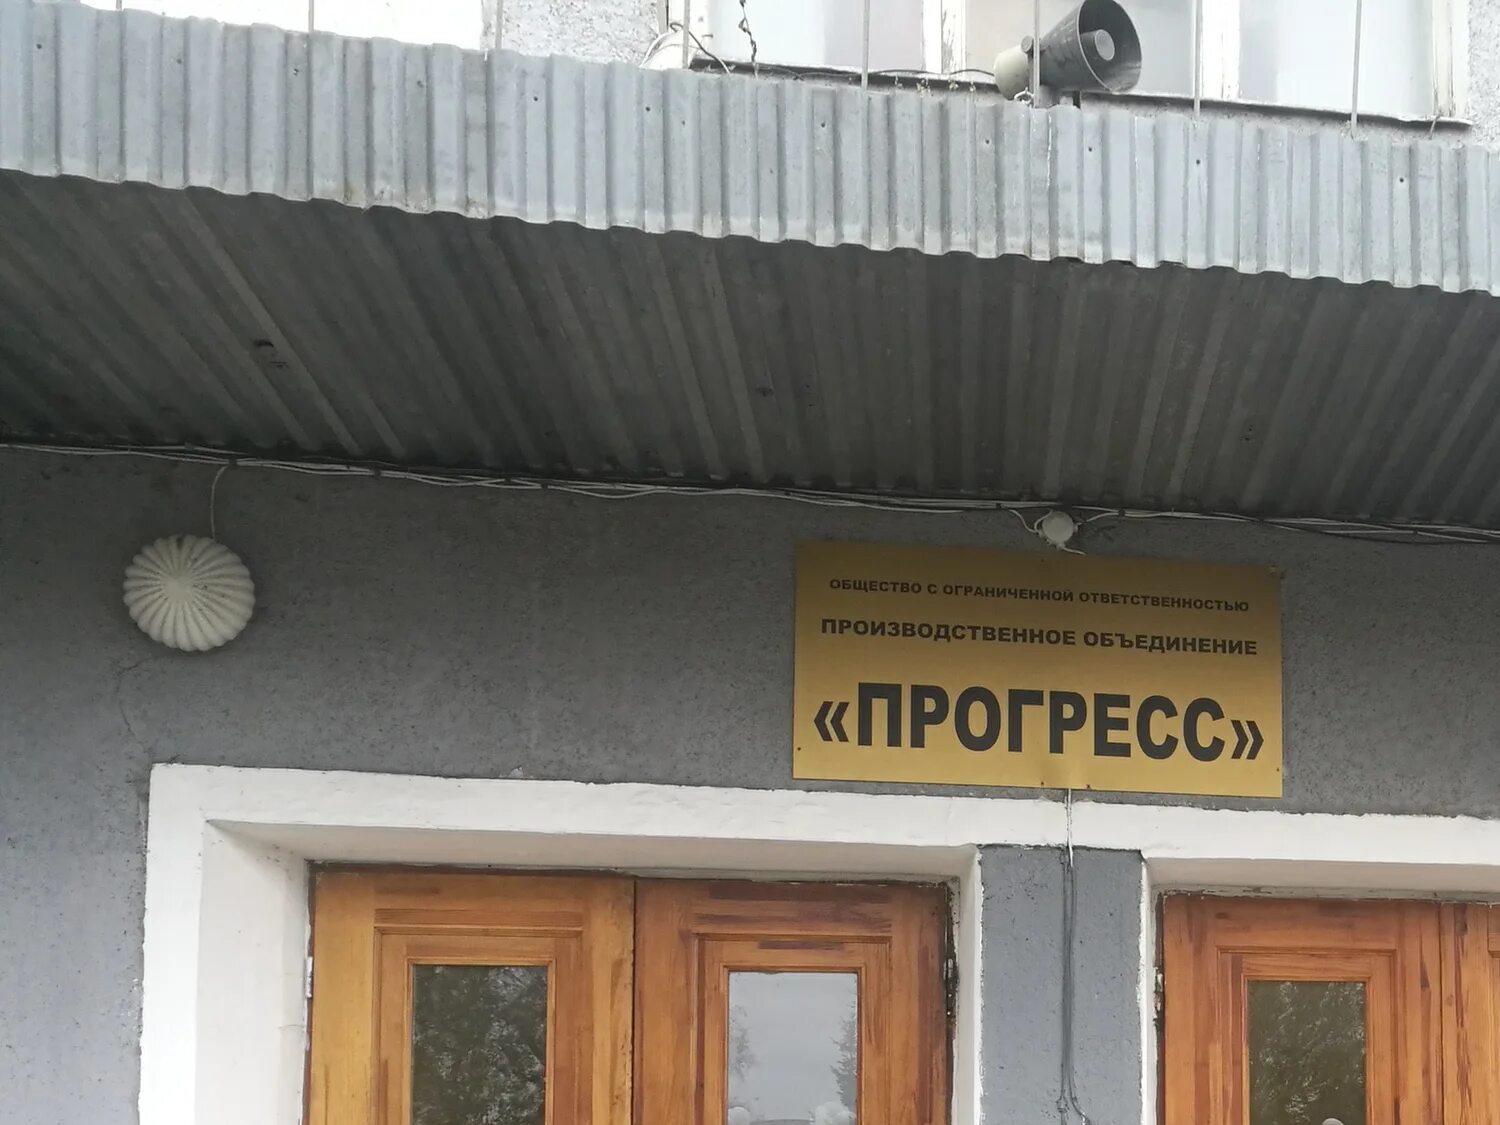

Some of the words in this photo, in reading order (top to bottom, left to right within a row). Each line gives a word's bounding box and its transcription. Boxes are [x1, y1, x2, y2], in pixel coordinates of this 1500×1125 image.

[829, 577, 922, 595] ОБЩЕСТВО
[927, 583, 938, 595] С
[942, 583, 1074, 603] ОГРАНИЧЕННОЙ
[1078, 590, 1249, 612] ОТВЕТСТВЕННОСТЬЮ
[820, 617, 1077, 646] ПРОИЗВОДСТВЕННОЕ
[1083, 631, 1258, 656] ОБЪЕДИНЕНИЕ
[813, 681, 1265, 762] «ПРОГРЕСС»
